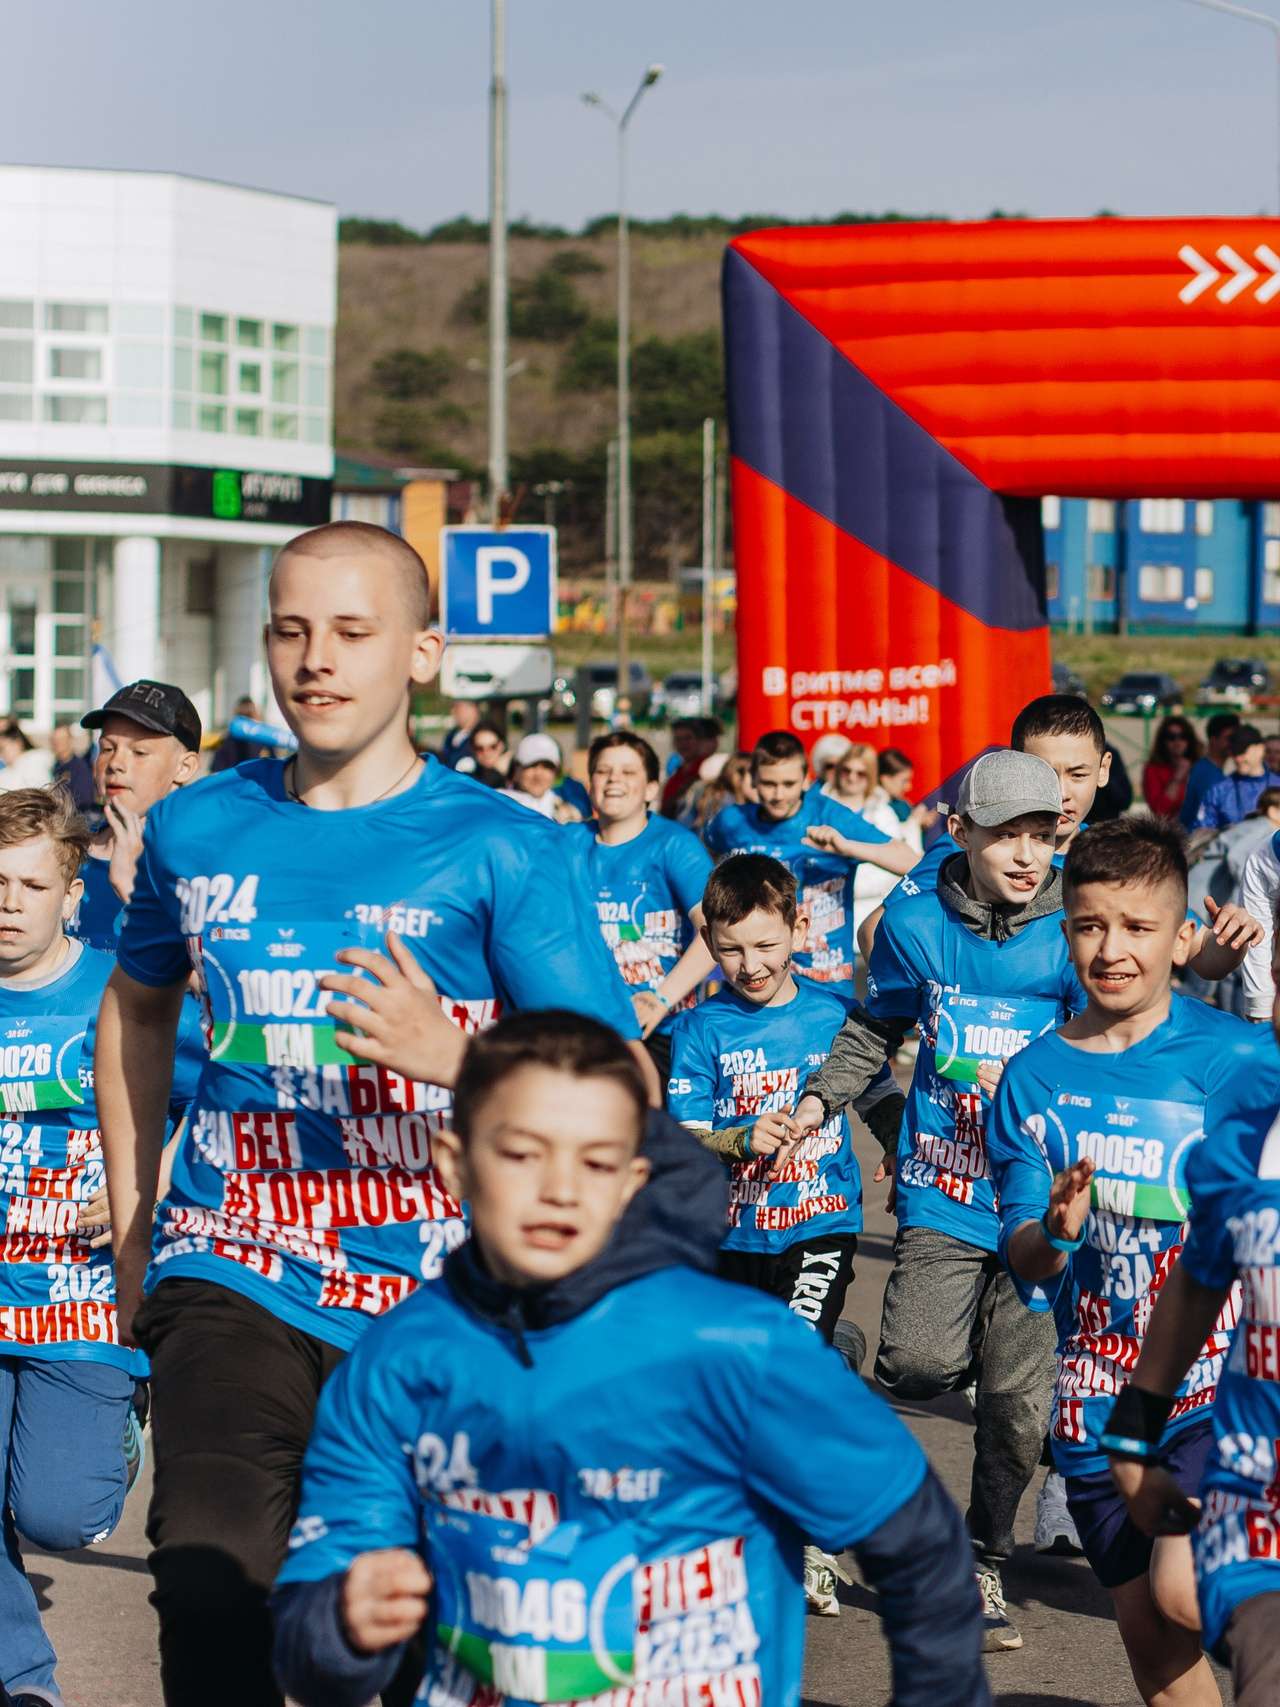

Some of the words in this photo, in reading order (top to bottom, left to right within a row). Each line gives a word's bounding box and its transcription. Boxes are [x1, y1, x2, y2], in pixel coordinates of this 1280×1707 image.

[762, 666, 787, 697] В
[791, 695, 929, 730] СТРАНЫ!
[720, 1047, 768, 1078] 2024
[731, 1067, 799, 1098] #МЕЧТА
[1076, 1130, 1165, 1179] 10058
